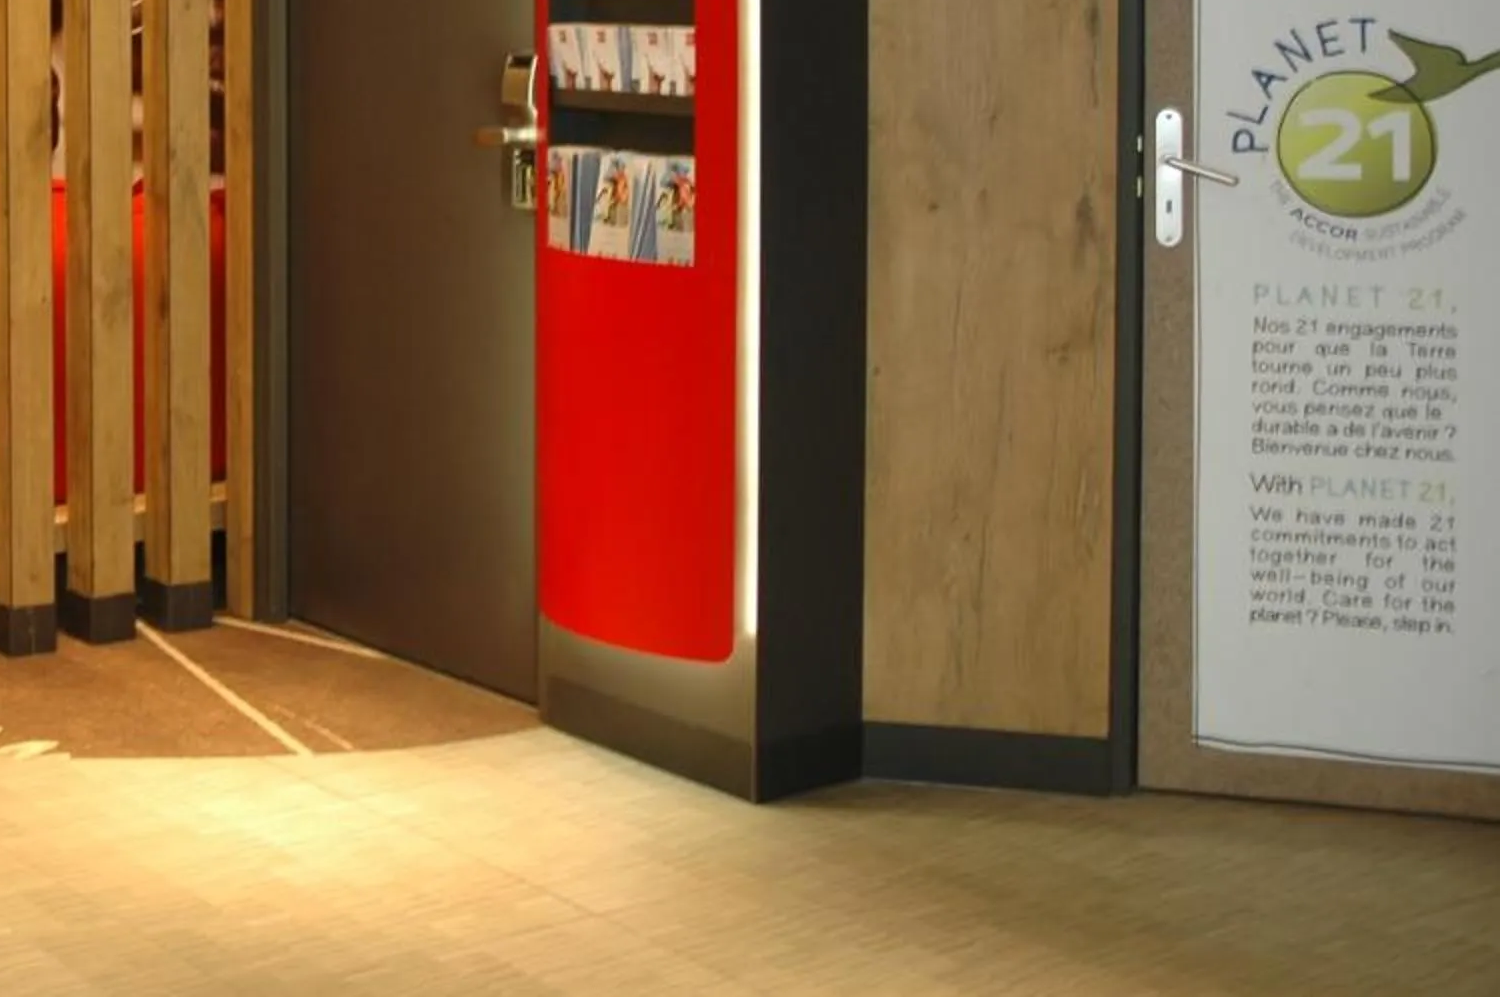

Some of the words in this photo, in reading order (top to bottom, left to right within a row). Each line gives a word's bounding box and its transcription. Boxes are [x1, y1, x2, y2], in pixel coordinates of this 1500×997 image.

[1226, 18, 1377, 154] PLANET
[1296, 107, 1412, 182] 21
[1289, 208, 1359, 243] ACCOR
[1253, 283, 1385, 309] PLANET
[1253, 316, 1291, 334] Nos
[1296, 319, 1318, 335] 21
[1325, 321, 1459, 340] engagements
[1252, 340, 1295, 357] pour
[1315, 342, 1350, 358] que
[1370, 341, 1388, 357] la
[1408, 342, 1457, 359] Terre
[1252, 359, 1314, 375] tourne
[1327, 364, 1352, 377] un
[1365, 364, 1402, 380] peu
[1415, 363, 1458, 382] plus
[1312, 380, 1390, 397] Comme
[1252, 400, 1298, 415] vous
[1303, 403, 1376, 420] pensez
[1382, 406, 1418, 422] que
[1426, 403, 1442, 420] le
[1252, 417, 1321, 435] durable
[1343, 420, 1366, 438] de
[1371, 421, 1439, 440] l'avenir
[1445, 424, 1457, 439] ?
[1252, 437, 1349, 457] Bienvenue
[1353, 443, 1400, 460] chez
[1250, 473, 1304, 495] With
[1310, 476, 1412, 500] PLANET
[1250, 506, 1283, 523] We
[1296, 508, 1346, 526] have
[1358, 513, 1417, 530] made
[1429, 515, 1457, 532] 21
[1251, 528, 1392, 549] commitments
[1398, 534, 1418, 551] to
[1425, 537, 1457, 552] act
[1250, 549, 1337, 567] together
[1365, 553, 1394, 569] for
[1422, 555, 1456, 572] the
[1384, 574, 1406, 589] of
[1421, 577, 1456, 593] our
[1322, 589, 1373, 608] Care
[1383, 593, 1413, 611] for
[1421, 595, 1456, 613] the
[1250, 607, 1302, 626] planet
[1306, 609, 1318, 625] ?
[1393, 616, 1431, 636] step
